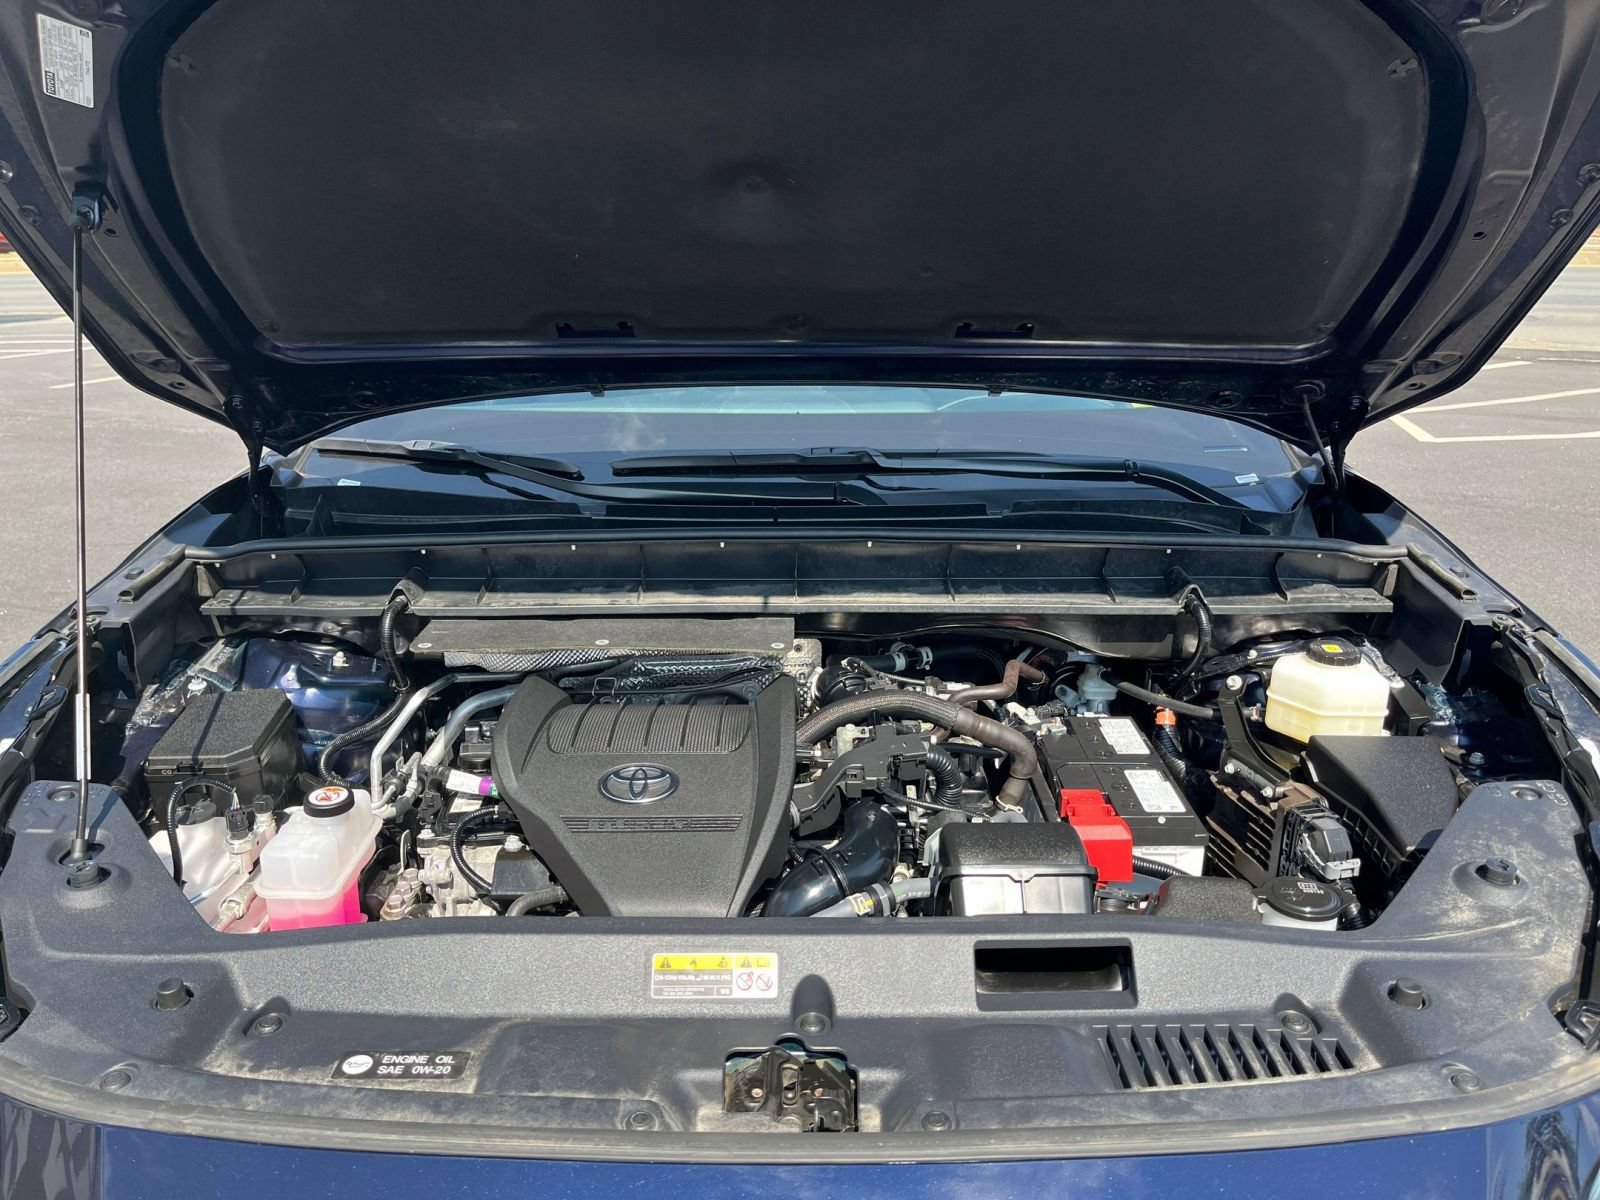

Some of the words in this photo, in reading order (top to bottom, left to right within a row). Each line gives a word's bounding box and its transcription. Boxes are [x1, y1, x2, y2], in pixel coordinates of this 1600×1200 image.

[46, 72, 55, 95] TOYOTA
[382, 1055, 429, 1064] ENGINE
[435, 1055, 455, 1064] OIL
[377, 1065, 404, 1074] SAE
[411, 1065, 451, 1074] 0W-20
